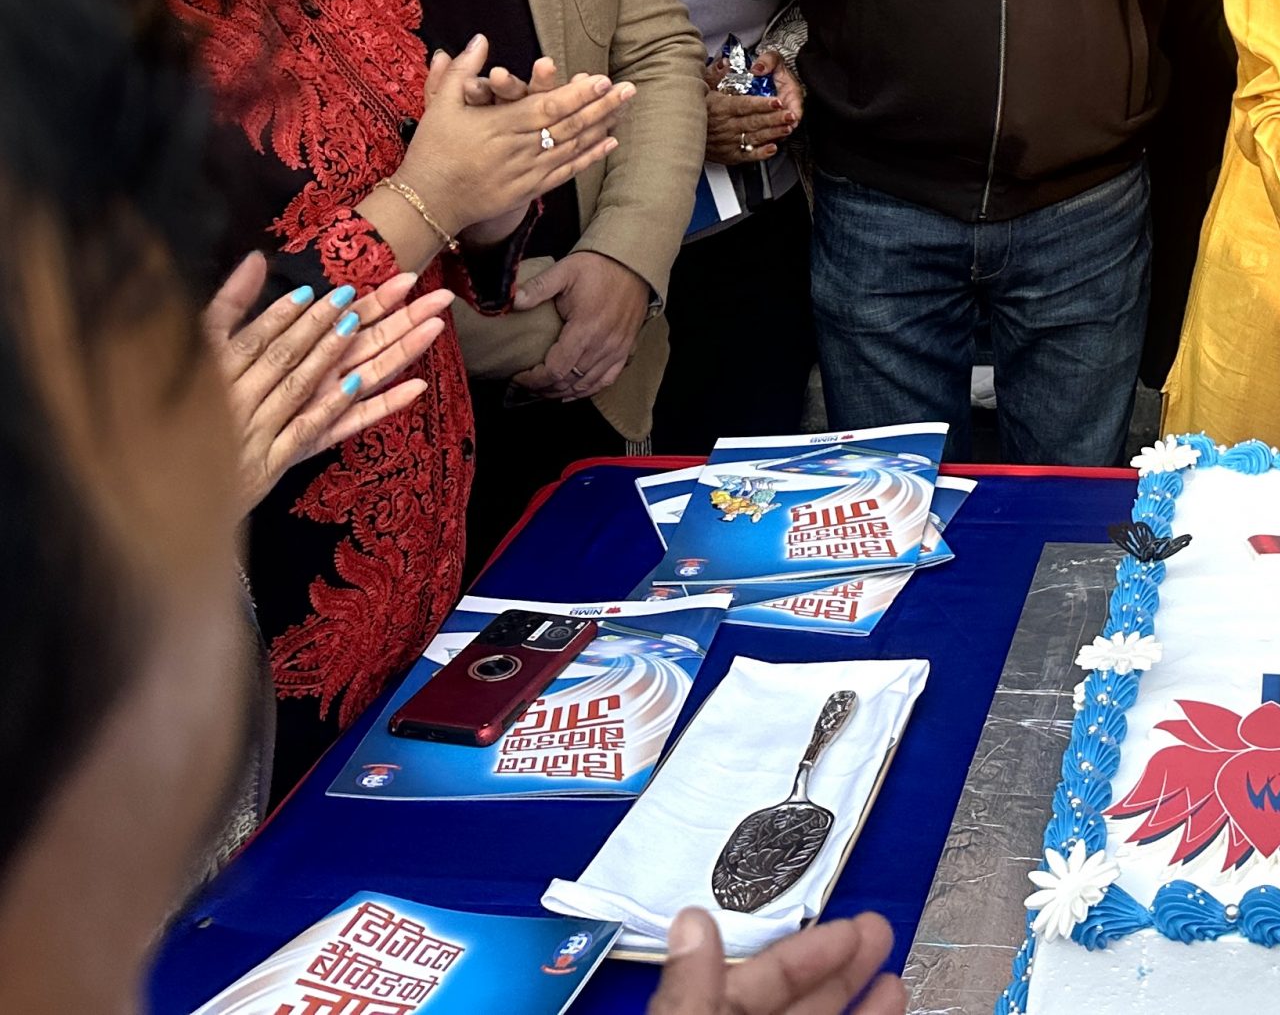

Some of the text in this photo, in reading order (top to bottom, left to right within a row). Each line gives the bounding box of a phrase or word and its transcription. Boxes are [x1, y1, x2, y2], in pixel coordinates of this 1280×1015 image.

[786, 539, 898, 560] डिजिटल
[569, 607, 604, 616] NIMB
[493, 752, 625, 782] डिजिटल
[338, 901, 467, 973] डिजिटल
